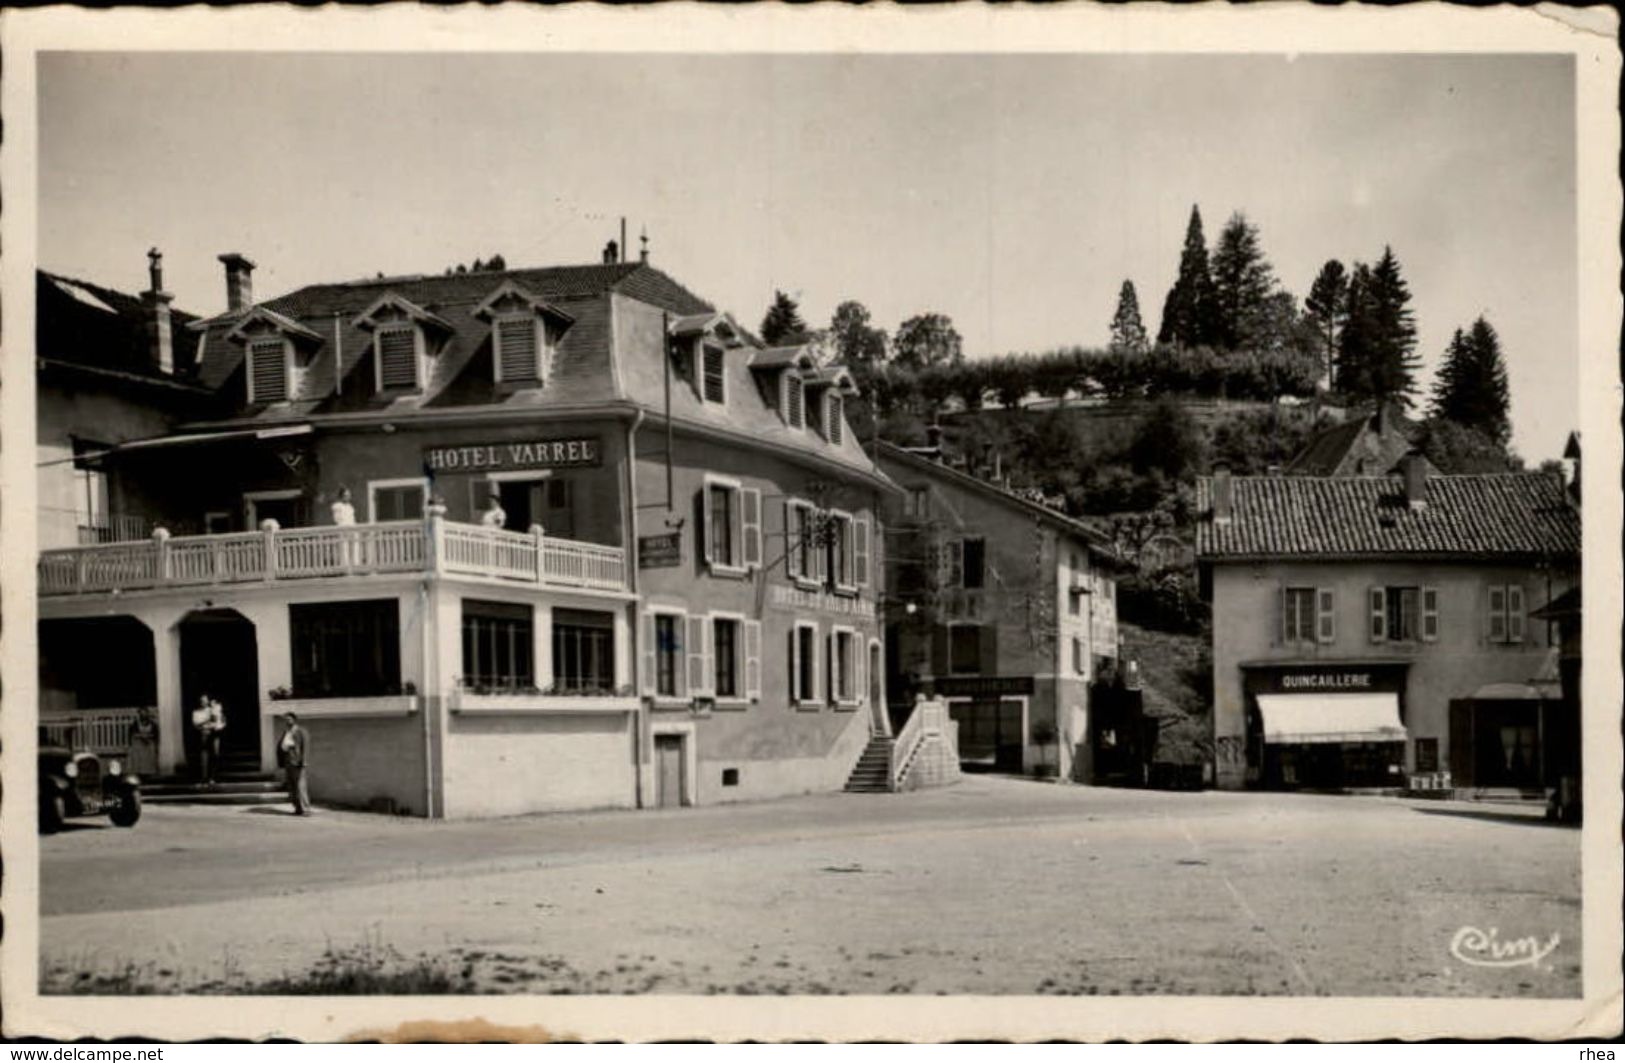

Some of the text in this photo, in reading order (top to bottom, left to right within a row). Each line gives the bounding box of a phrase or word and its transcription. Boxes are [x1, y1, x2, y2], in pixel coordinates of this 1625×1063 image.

[430, 441, 594, 468] HOTEL VARREL
[1282, 673, 1371, 688] QUINCAILLERIE
